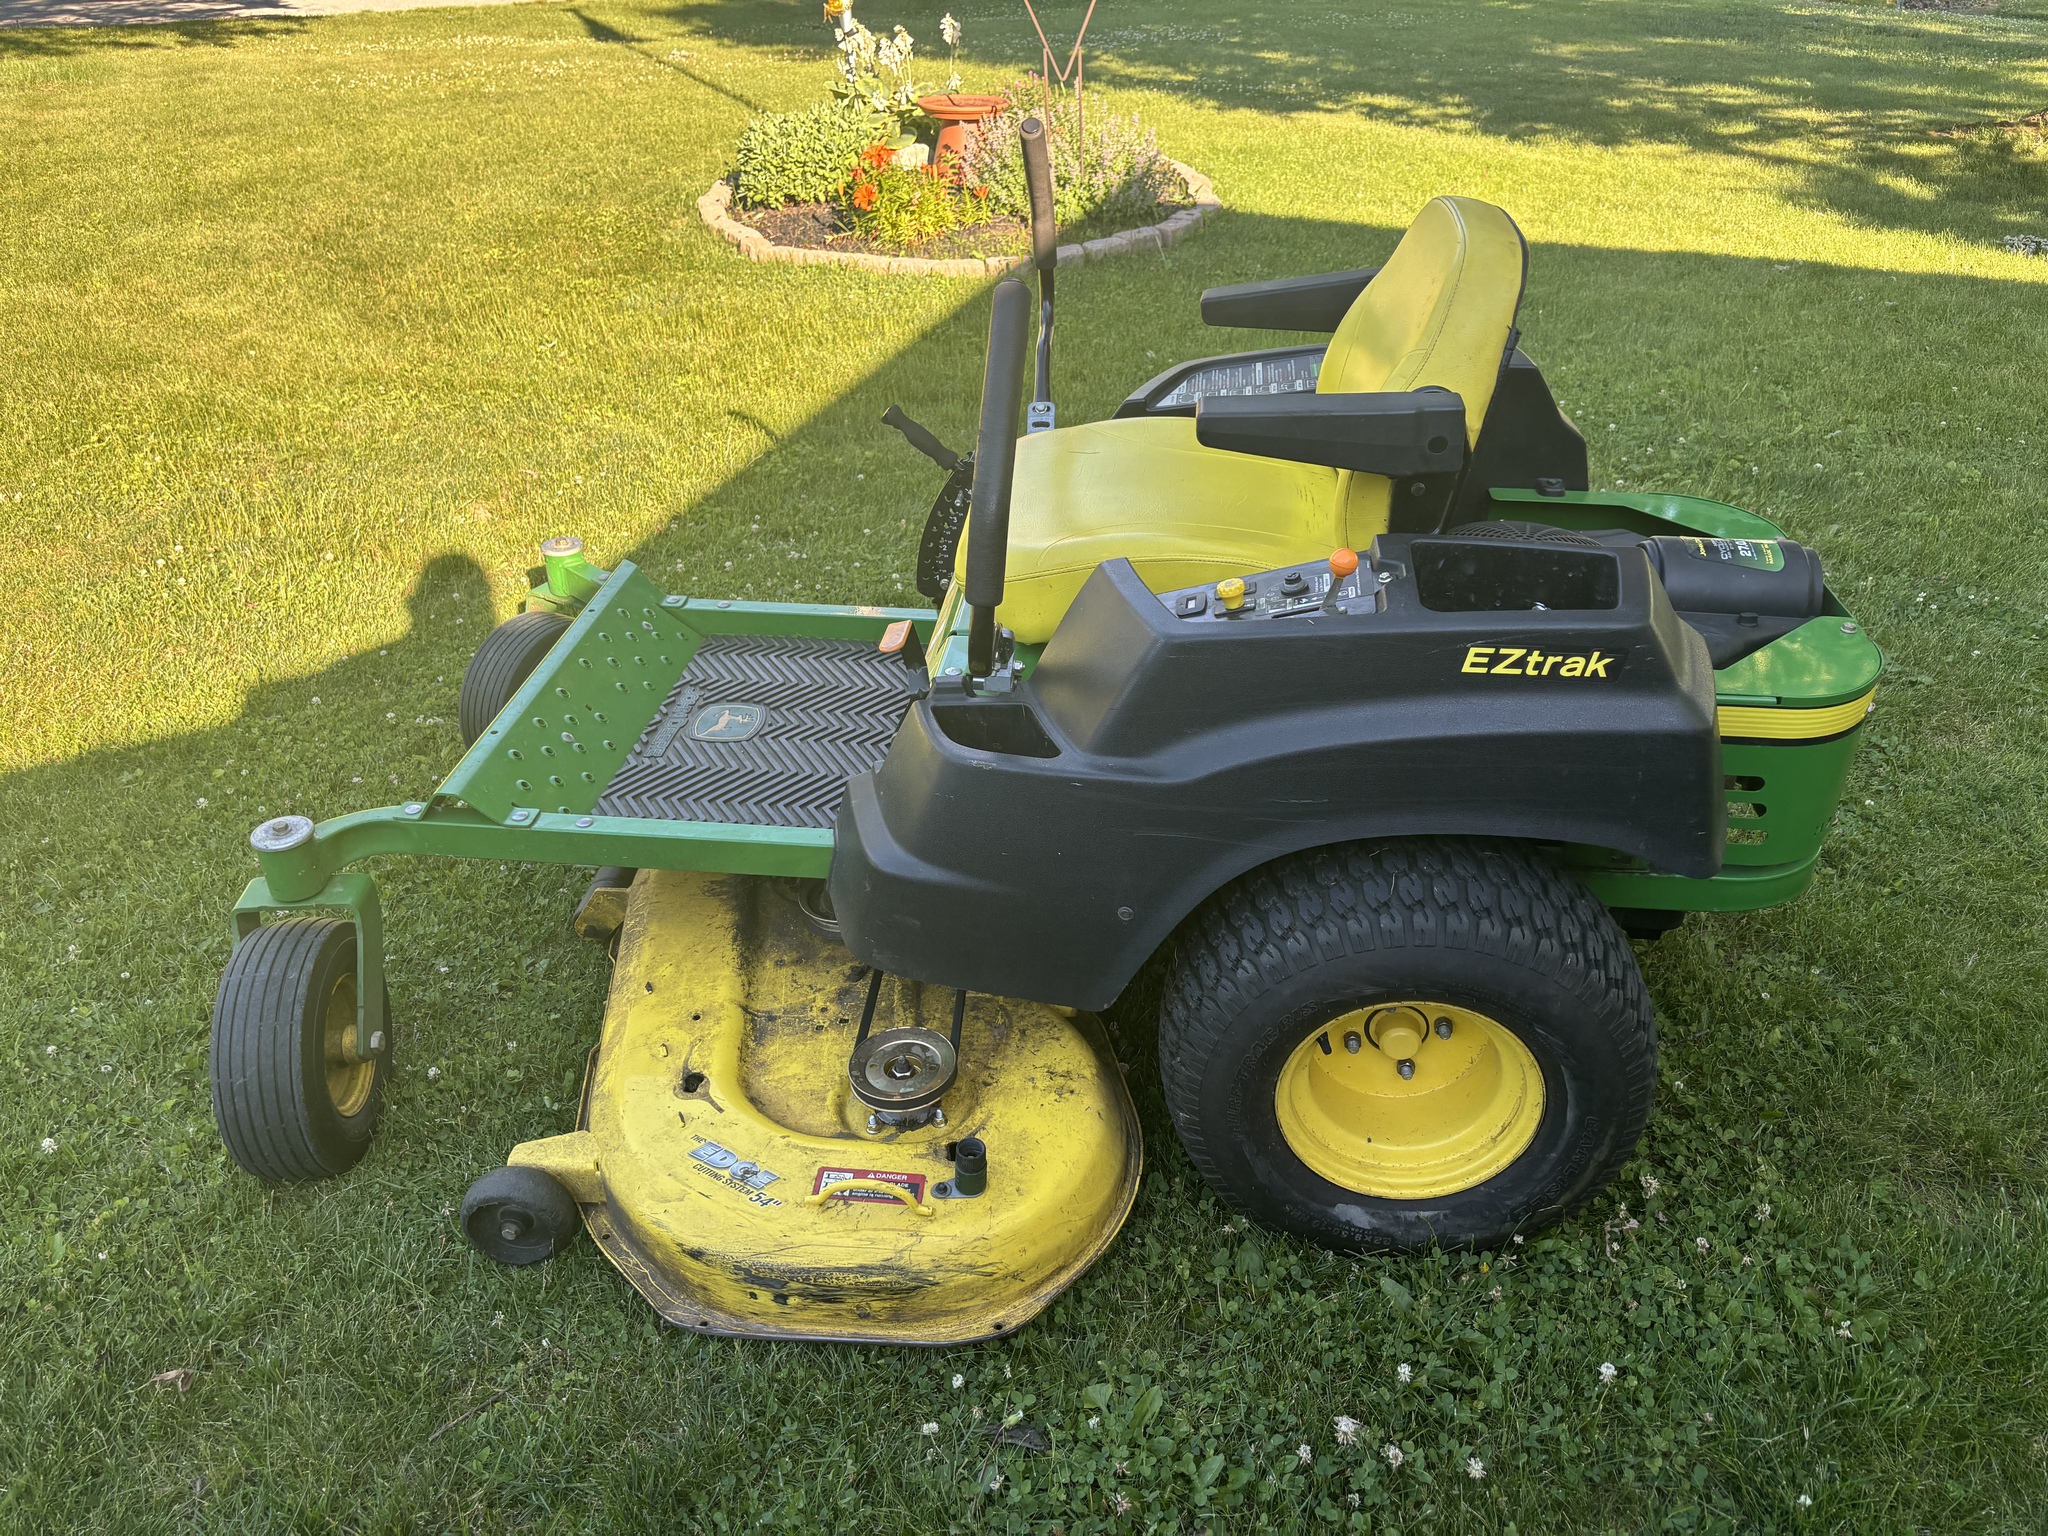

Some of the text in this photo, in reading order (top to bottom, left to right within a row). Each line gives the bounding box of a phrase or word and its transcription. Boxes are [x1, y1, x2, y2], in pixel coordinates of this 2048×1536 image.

[1461, 647, 1615, 678] EZtrak
[690, 1134, 706, 1144] THE
[687, 1141, 781, 1190] EDGE
[876, 1172, 908, 1181] DANGER
[1513, 1115, 1600, 1221] CARLISLE
[692, 1163, 783, 1207] CUTTING SYSTEM 54"
